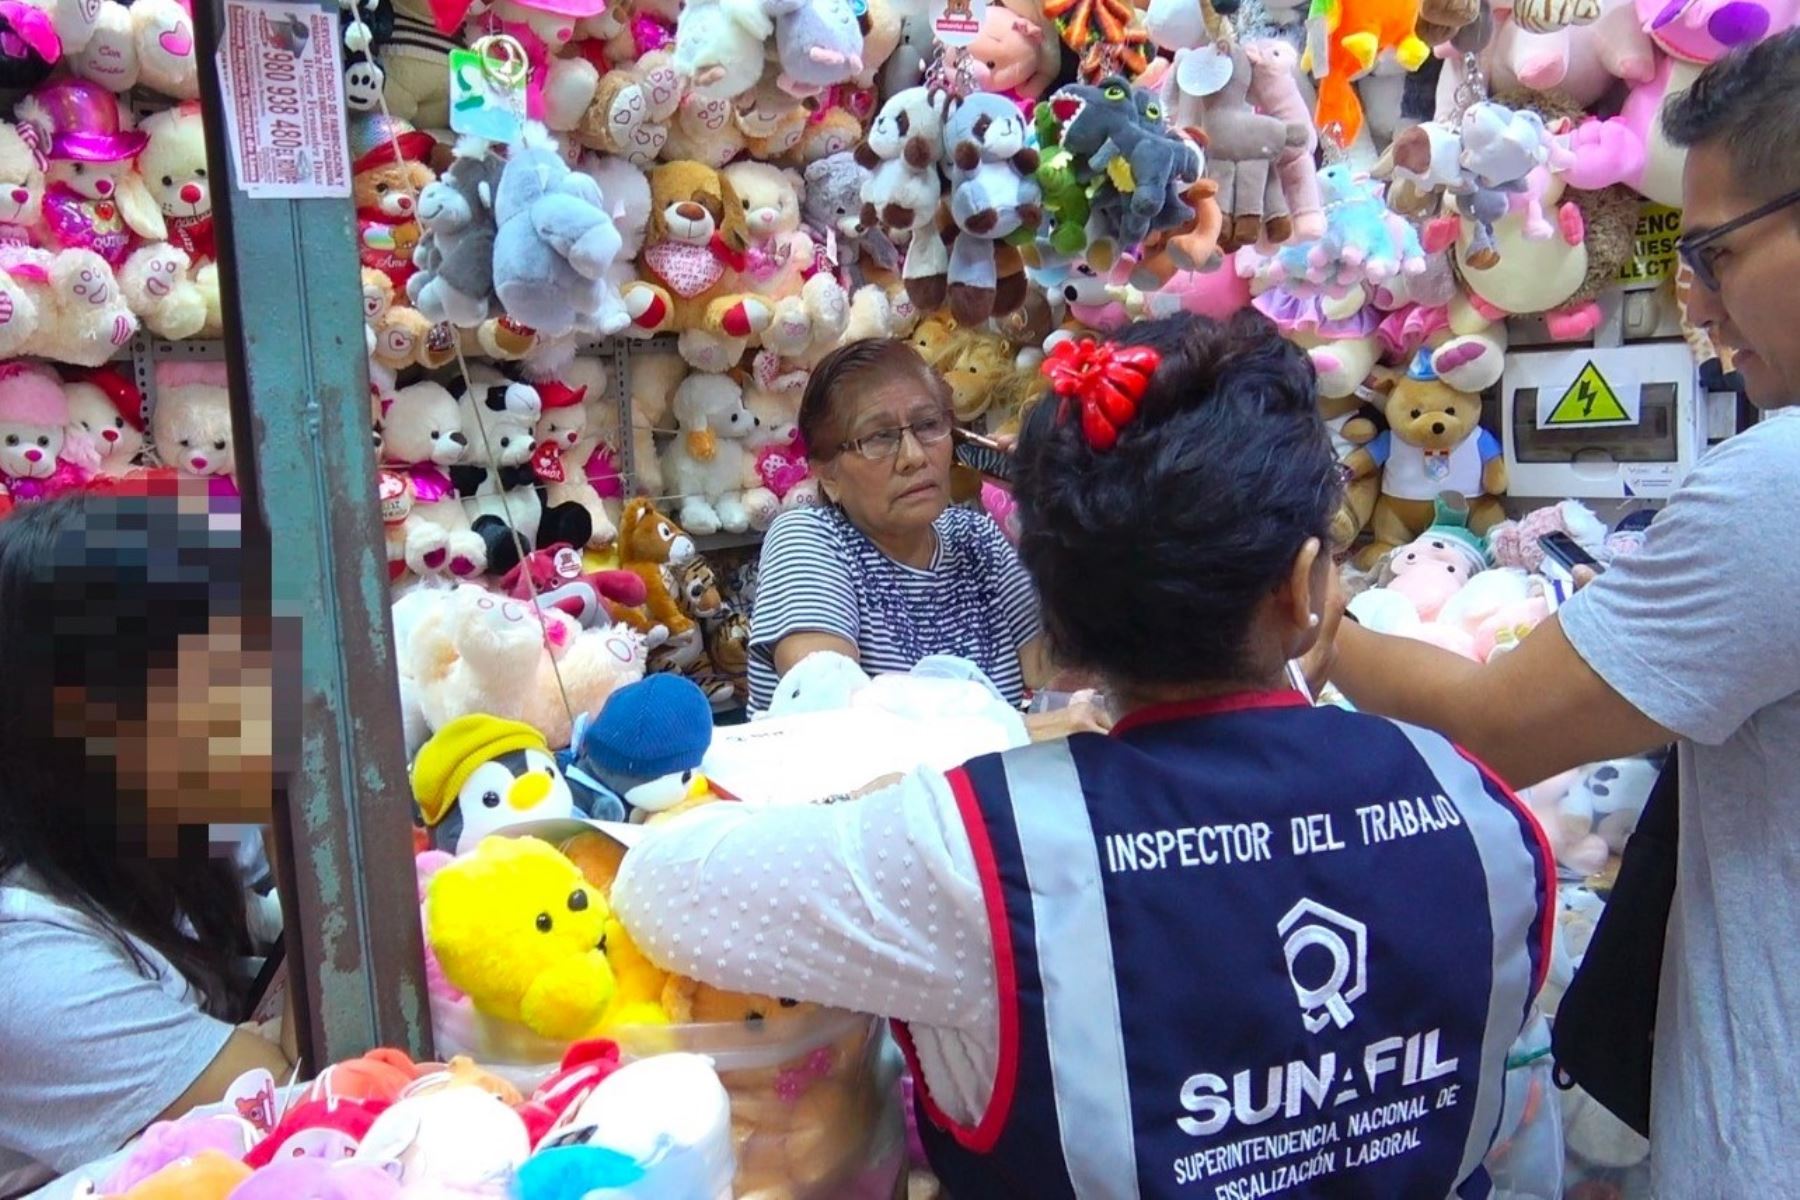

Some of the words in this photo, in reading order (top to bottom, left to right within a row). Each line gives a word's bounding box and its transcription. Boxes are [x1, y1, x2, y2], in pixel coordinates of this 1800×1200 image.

[320, 16, 332, 59] SERVICIO
[263, 52, 295, 82] 980
[324, 62, 336, 101] TÉCNICO
[267, 86, 299, 114] 938
[328, 104, 337, 115] DE
[270, 120, 303, 148] 480
[330, 118, 344, 178] FABRICACIÓN
[1635, 212, 1679, 236] ENC
[1619, 258, 1672, 279] LECT
[1105, 821, 1273, 873] INSPECTOR
[1291, 814, 1345, 856] DEL
[1355, 794, 1461, 846] TRABAJO
[1176, 1028, 1460, 1137] SUNAFIL
[1173, 1124, 1338, 1186] SUPERINTENDENCIA
[1347, 1096, 1429, 1138] NACIONAL
[1436, 1084, 1461, 1110] DE
[1215, 1147, 1335, 1200] FISCALIZACIÓN
[1345, 1127, 1421, 1168] LABORAL
